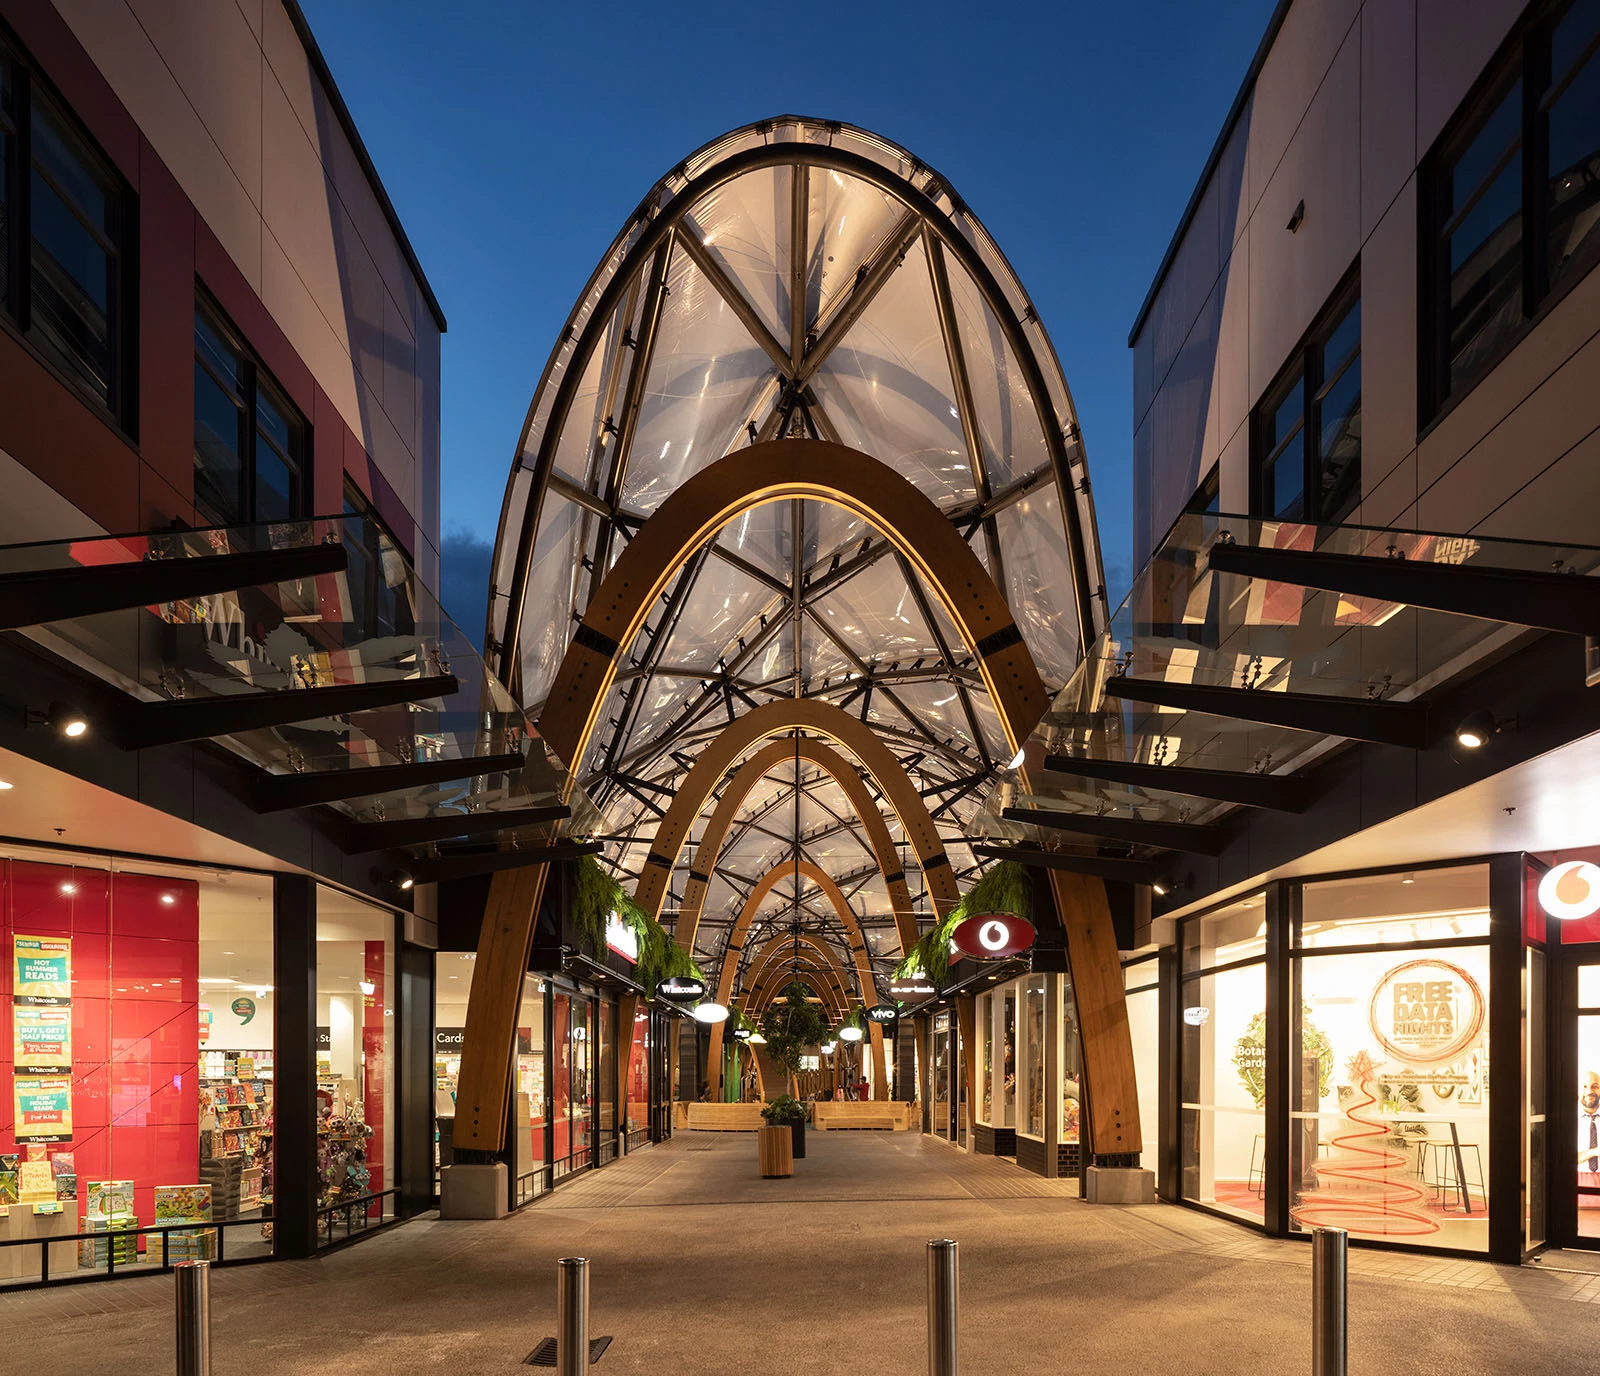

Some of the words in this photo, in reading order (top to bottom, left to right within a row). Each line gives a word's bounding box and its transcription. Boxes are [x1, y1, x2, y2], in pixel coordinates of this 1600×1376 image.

[25, 965, 58, 973] SUMMER
[25, 972, 58, 981] READS
[1394, 981, 1453, 1003] FREE
[1394, 1003, 1454, 1021] DATA
[1394, 1022, 1454, 1036] NIGHTS
